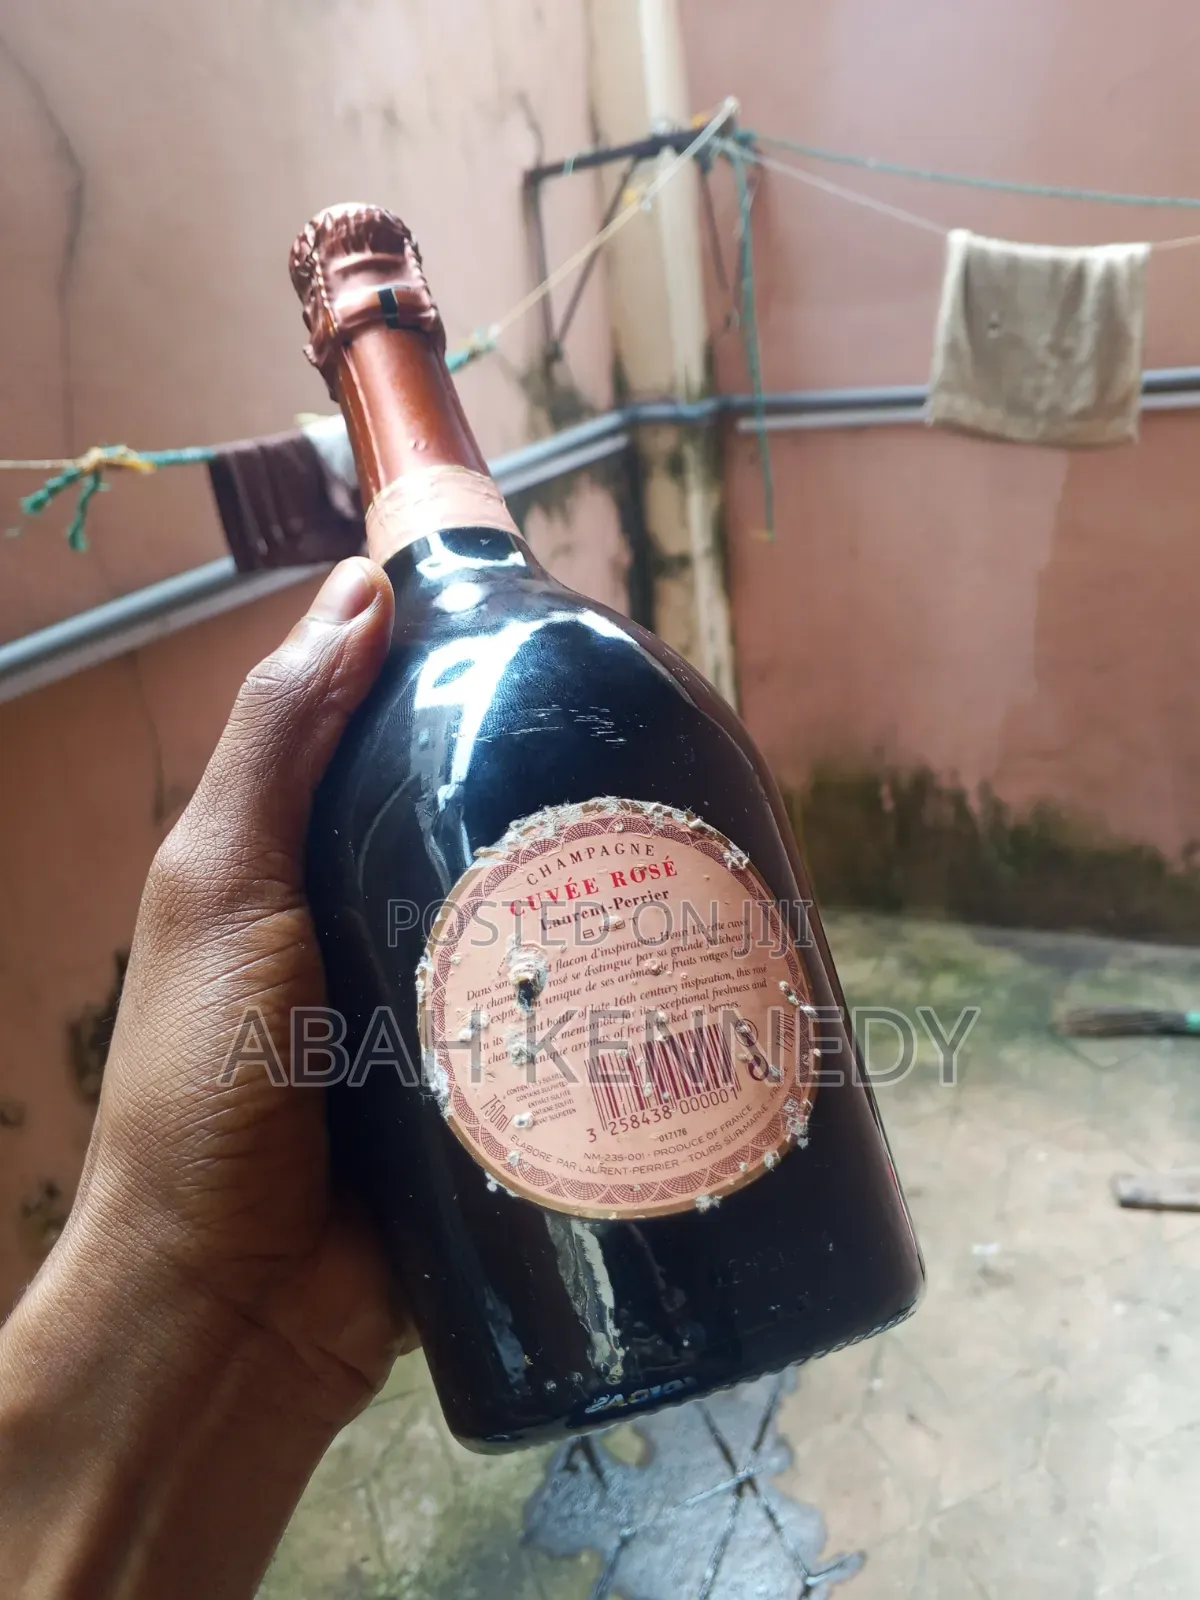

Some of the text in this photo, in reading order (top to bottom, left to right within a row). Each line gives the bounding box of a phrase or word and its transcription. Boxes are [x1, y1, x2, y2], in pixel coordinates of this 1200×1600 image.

[509, 856, 678, 917] CUVÉE ROSÉ
[526, 842, 656, 886] CHAMPAGNE
[540, 890, 670, 931] Laurent-Perrier
[467, 986, 492, 1001] Dans
[556, 953, 588, 974] flacon
[590, 936, 656, 961] d'inspiration
[545, 987, 582, 1005] unique
[585, 981, 597, 993] de
[600, 976, 615, 988] ses
[618, 966, 661, 983] arôme
[671, 955, 698, 972] fruits
[700, 950, 729, 963] rouges
[548, 977, 568, 988] rosé
[572, 973, 581, 981] se
[584, 957, 632, 978] distingue
[636, 952, 654, 966] par
[656, 946, 668, 957] sa
[670, 938, 704, 956] grande
[493, 1036, 503, 1046] its
[547, 1012, 574, 1027] bottle
[578, 1007, 588, 1020] of
[591, 1001, 610, 1014] late
[614, 994, 636, 1007] 16th
[640, 982, 679, 1001] century
[681, 971, 735, 990] inspiration,
[736, 967, 751, 978] this
[561, 1014, 618, 1040] memorable
[620, 1008, 636, 1025] for
[655, 988, 710, 1011] exceptional
[712, 980, 751, 999] freshness
[752, 977, 768, 990] and
[570, 1033, 612, 1053] aromas
[613, 1025, 625, 1040] of
[480, 1094, 514, 1134] 750ml
[516, 1089, 541, 1102] CONTAINS
[532, 1105, 555, 1117] ONTIENE
[586, 1087, 739, 1143] 3 258438 000001
[510, 1134, 553, 1162] ELABORE
[557, 1158, 577, 1171] PAR
[579, 1159, 680, 1176] LAURENT-PERRIER
[688, 1141, 723, 1162] TOURS
[653, 1135, 706, 1158] PRODUCE
[706, 1128, 719, 1140] OF
[720, 1104, 753, 1132] FRANCE
